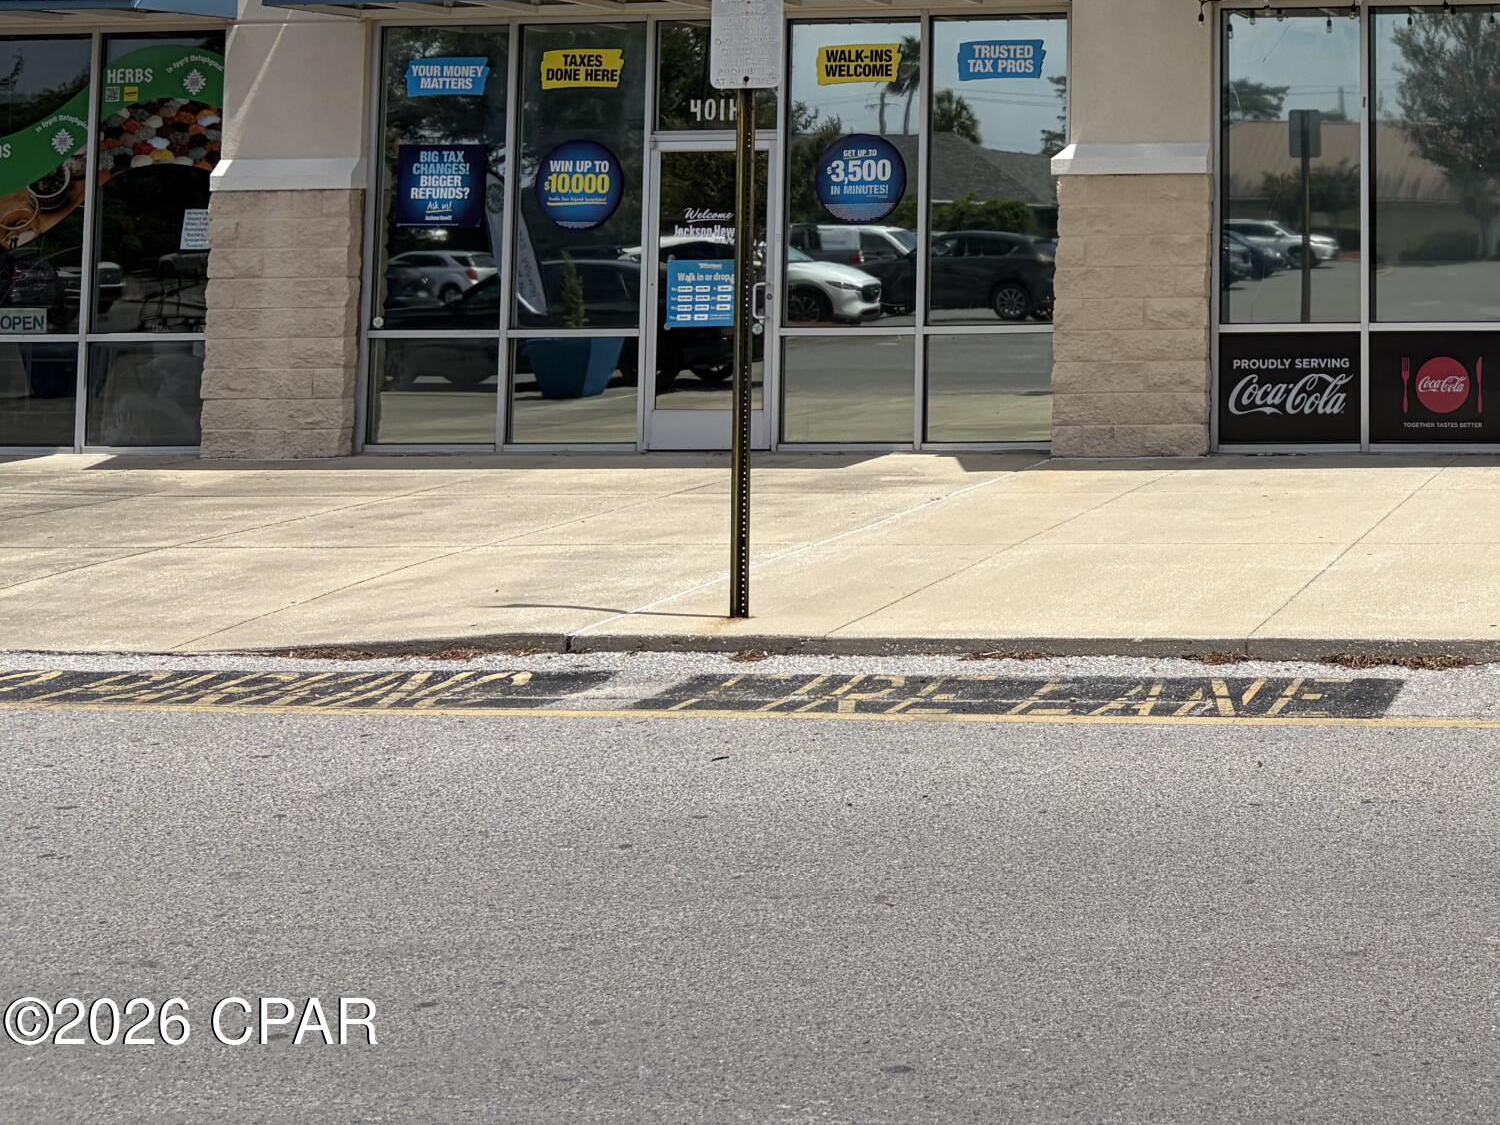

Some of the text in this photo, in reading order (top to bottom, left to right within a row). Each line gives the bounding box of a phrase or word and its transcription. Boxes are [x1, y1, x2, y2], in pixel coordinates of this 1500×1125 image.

[825, 49, 892, 63] WALK-INS
[973, 45, 1034, 58] TRUSTED
[562, 54, 603, 67] TAXES
[967, 59, 1034, 73] TAX PROS
[107, 68, 153, 84] HERBS
[411, 65, 485, 77] YOUR MONEY
[546, 68, 618, 82] DONE HERE
[825, 63, 892, 77] WELCOME
[420, 78, 473, 89] MATTERS
[420, 151, 465, 162] BIG TAX
[843, 149, 856, 157] GET
[412, 163, 470, 174] CHANGES!
[549, 160, 609, 172] WIN UP TO
[826, 159, 892, 184] $3,500
[420, 175, 462, 186] BIGGER
[544, 173, 610, 194] $10,000
[410, 187, 470, 199] REFUNDS?
[830, 184, 888, 195] IN MINUTES!
[683, 207, 735, 220] Welcome
[713, 225, 735, 237] Hew
[0, 315, 45, 330] OPEN
[1233, 358, 1350, 369] PROUDLY SERVING
[1418, 375, 1467, 393] Coca-Cola
[1228, 373, 1354, 415] Coca-Cola
[1007, 677, 1353, 718] LANE
